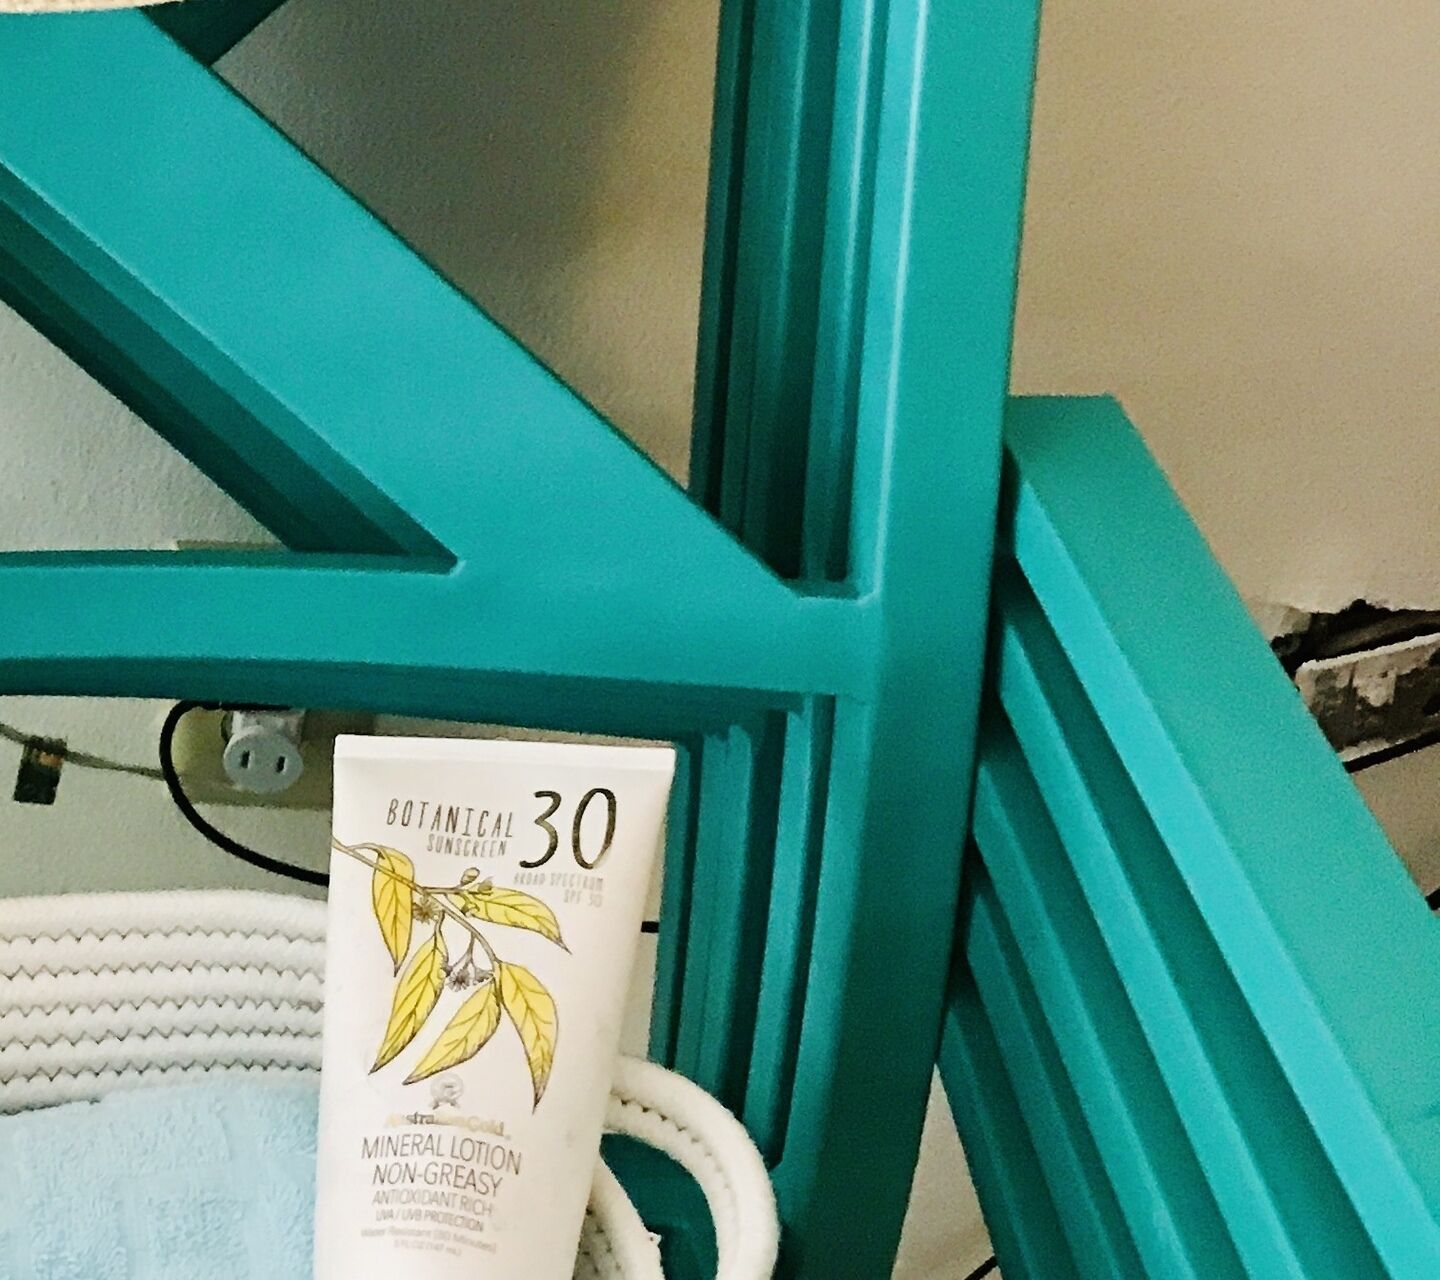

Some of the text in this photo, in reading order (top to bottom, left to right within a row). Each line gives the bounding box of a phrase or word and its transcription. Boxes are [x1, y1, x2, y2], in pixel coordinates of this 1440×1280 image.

[387, 798, 513, 838] BOTANICAL
[519, 787, 617, 870] 30
[426, 833, 507, 858] SUNSCREEN
[361, 1133, 522, 1176] MINERAL LOTION
[372, 1161, 503, 1197] NON-GREASY
[372, 1188, 495, 1218] ANTIOXIDANT RICH
[423, 1209, 485, 1232] PROTECTION
